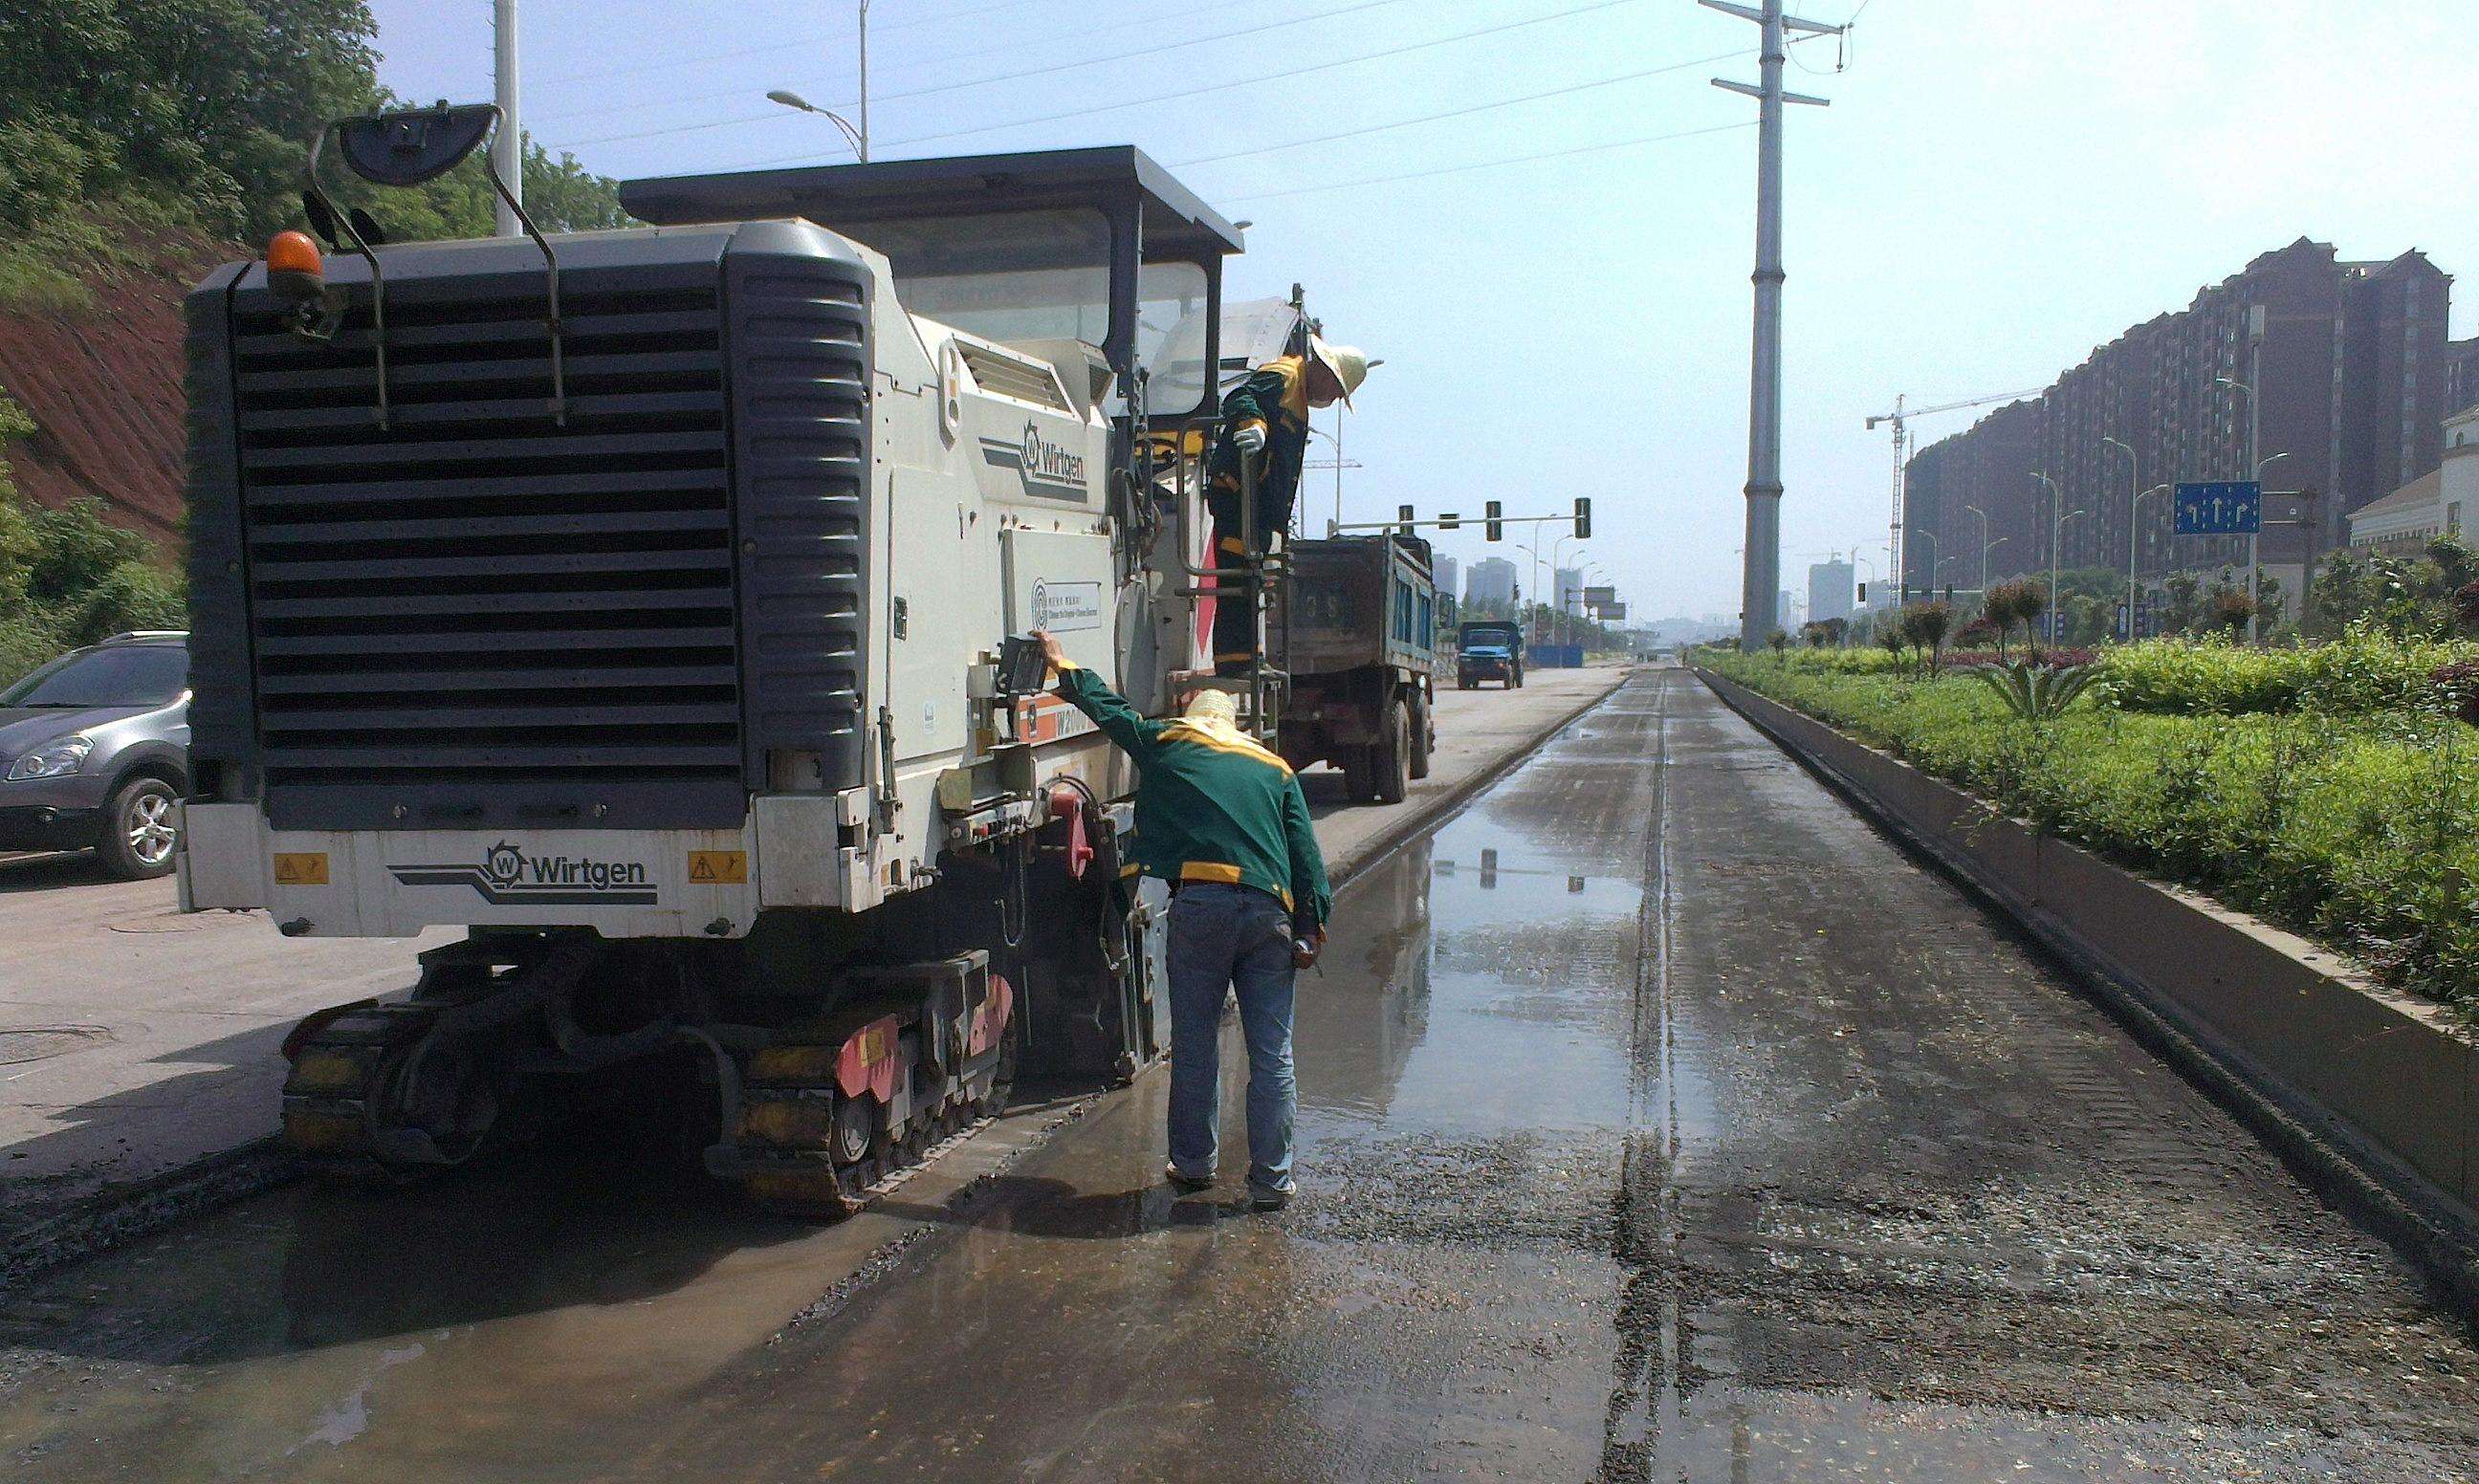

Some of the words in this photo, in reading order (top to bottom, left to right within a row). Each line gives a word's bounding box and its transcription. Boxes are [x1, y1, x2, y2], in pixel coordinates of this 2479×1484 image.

[1042, 442, 1084, 485] Wirtgen
[495, 857, 516, 874] W
[531, 857, 646, 890] Wirtgen
